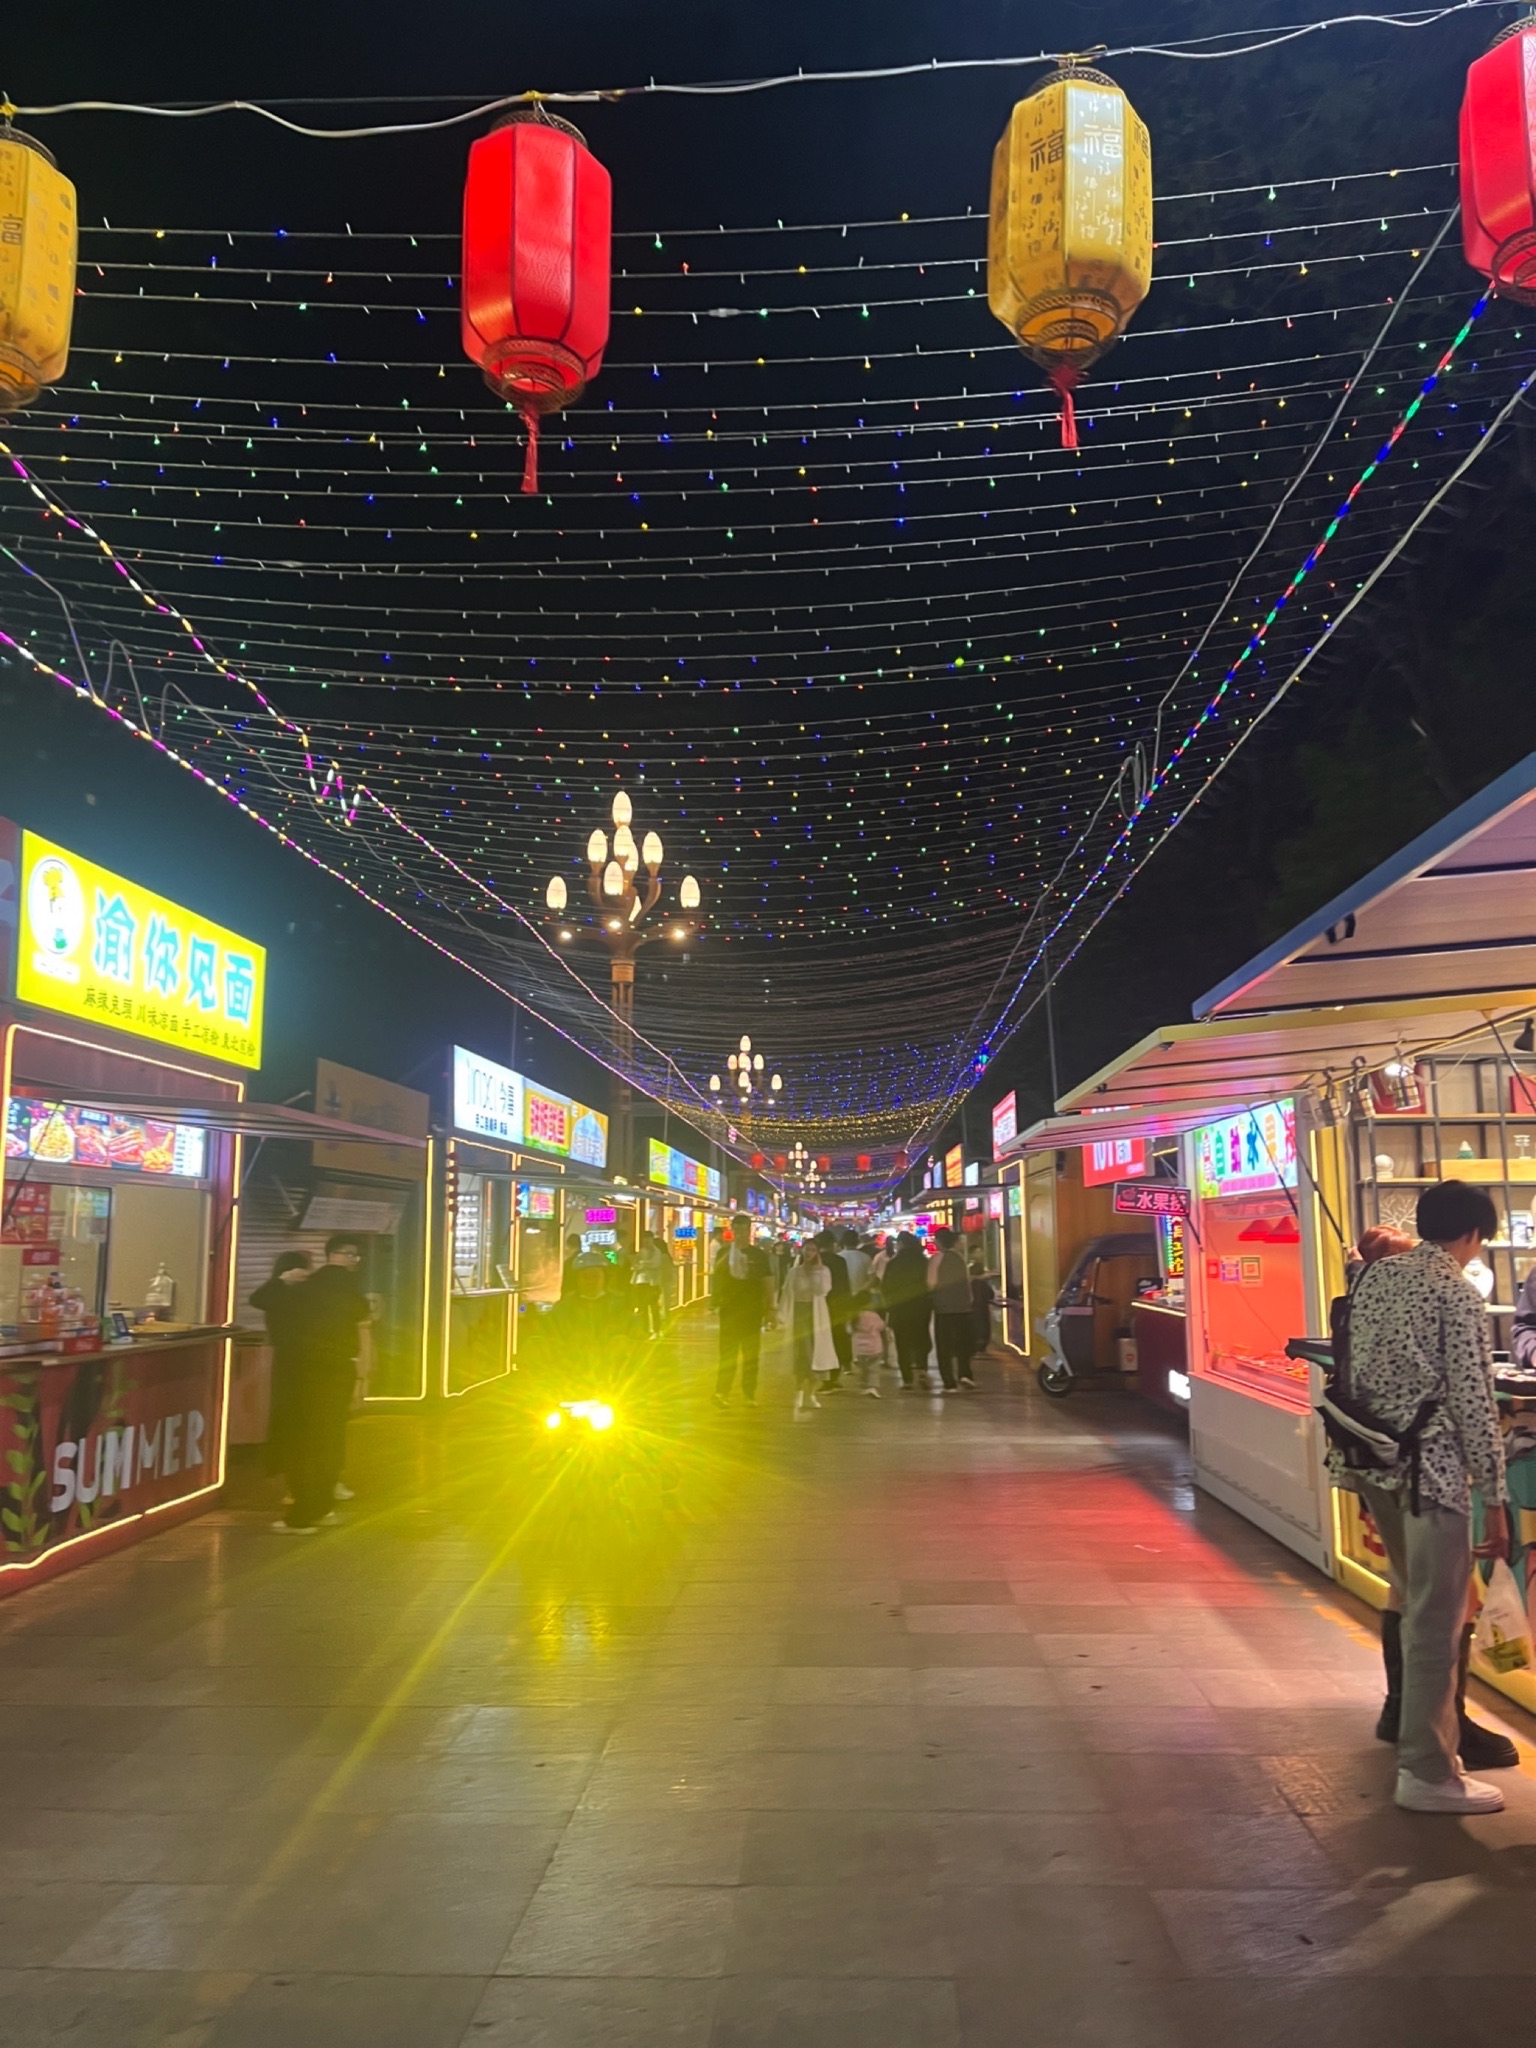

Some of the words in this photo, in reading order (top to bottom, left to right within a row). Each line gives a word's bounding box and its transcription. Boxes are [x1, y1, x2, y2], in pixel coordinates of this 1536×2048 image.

[1030, 129, 1063, 173] 福
[1083, 125, 1121, 158] 福
[94, 888, 255, 1026] 渝你见面
[50, 1409, 206, 1513] SUMMER
